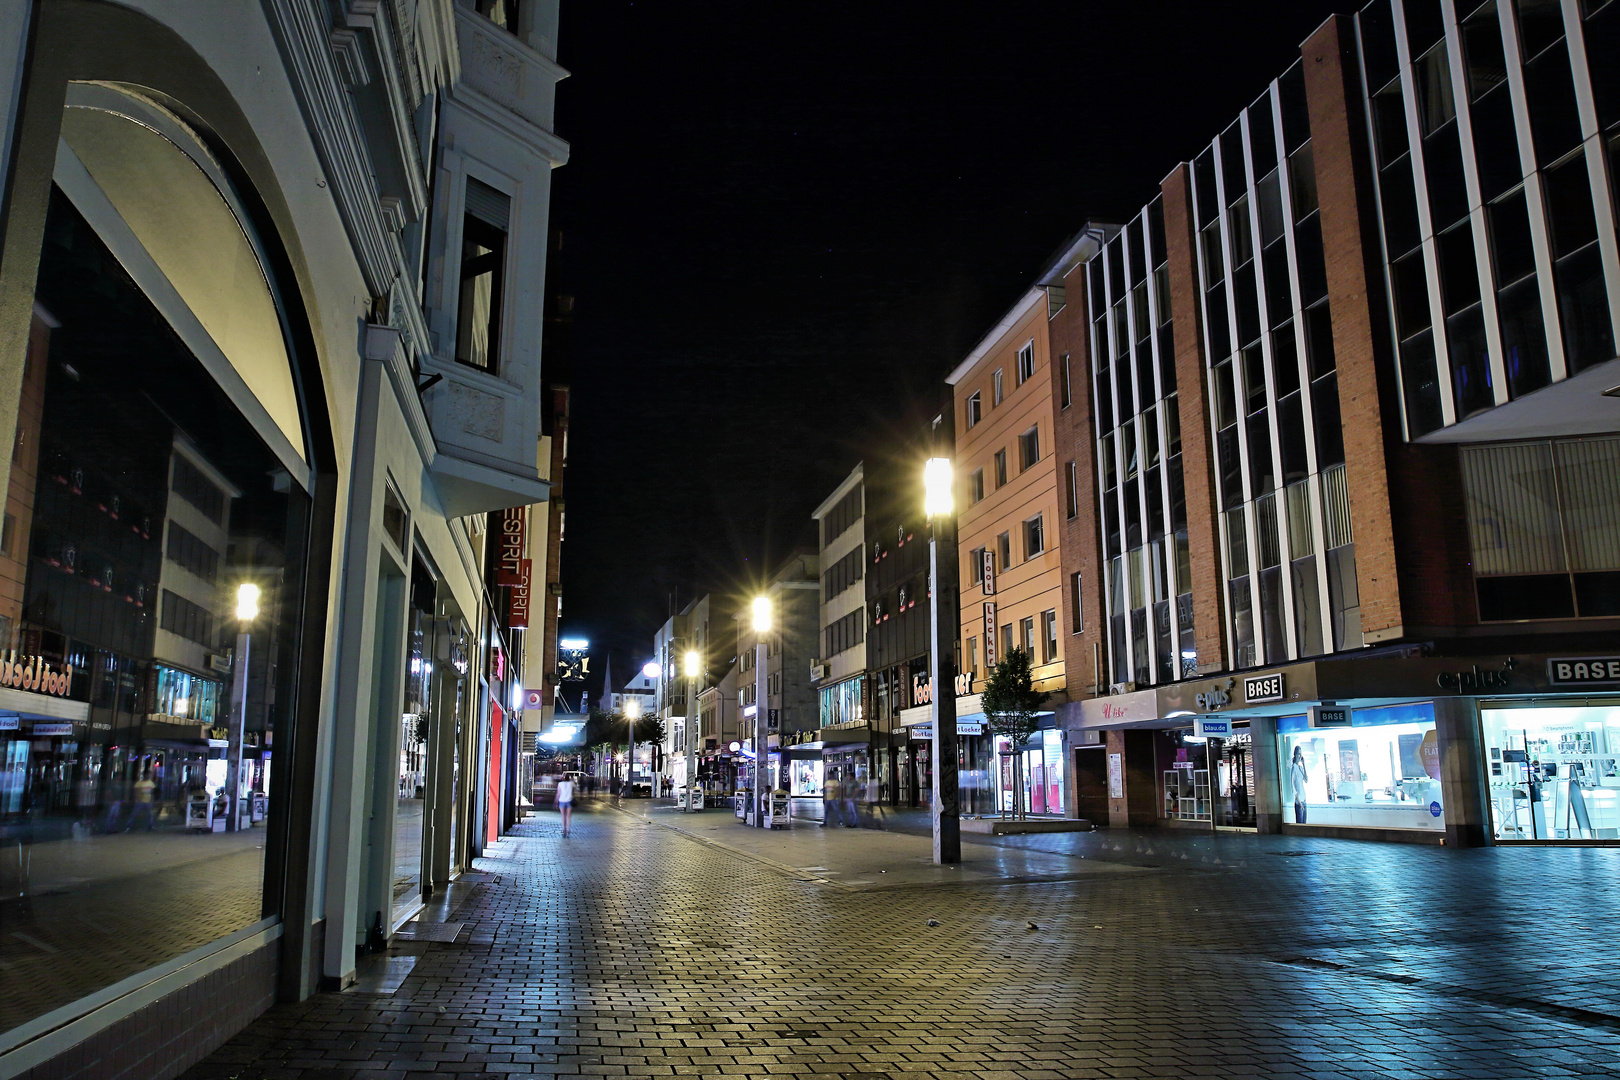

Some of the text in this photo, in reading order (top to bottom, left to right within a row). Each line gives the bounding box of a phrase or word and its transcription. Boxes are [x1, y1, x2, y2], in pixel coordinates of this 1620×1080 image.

[502, 508, 522, 575] ESPRIT
[1557, 662, 1620, 681] BASE
[1248, 679, 1279, 698] BASE
[1322, 712, 1344, 721] BASE
[1204, 723, 1226, 732] blau.de
